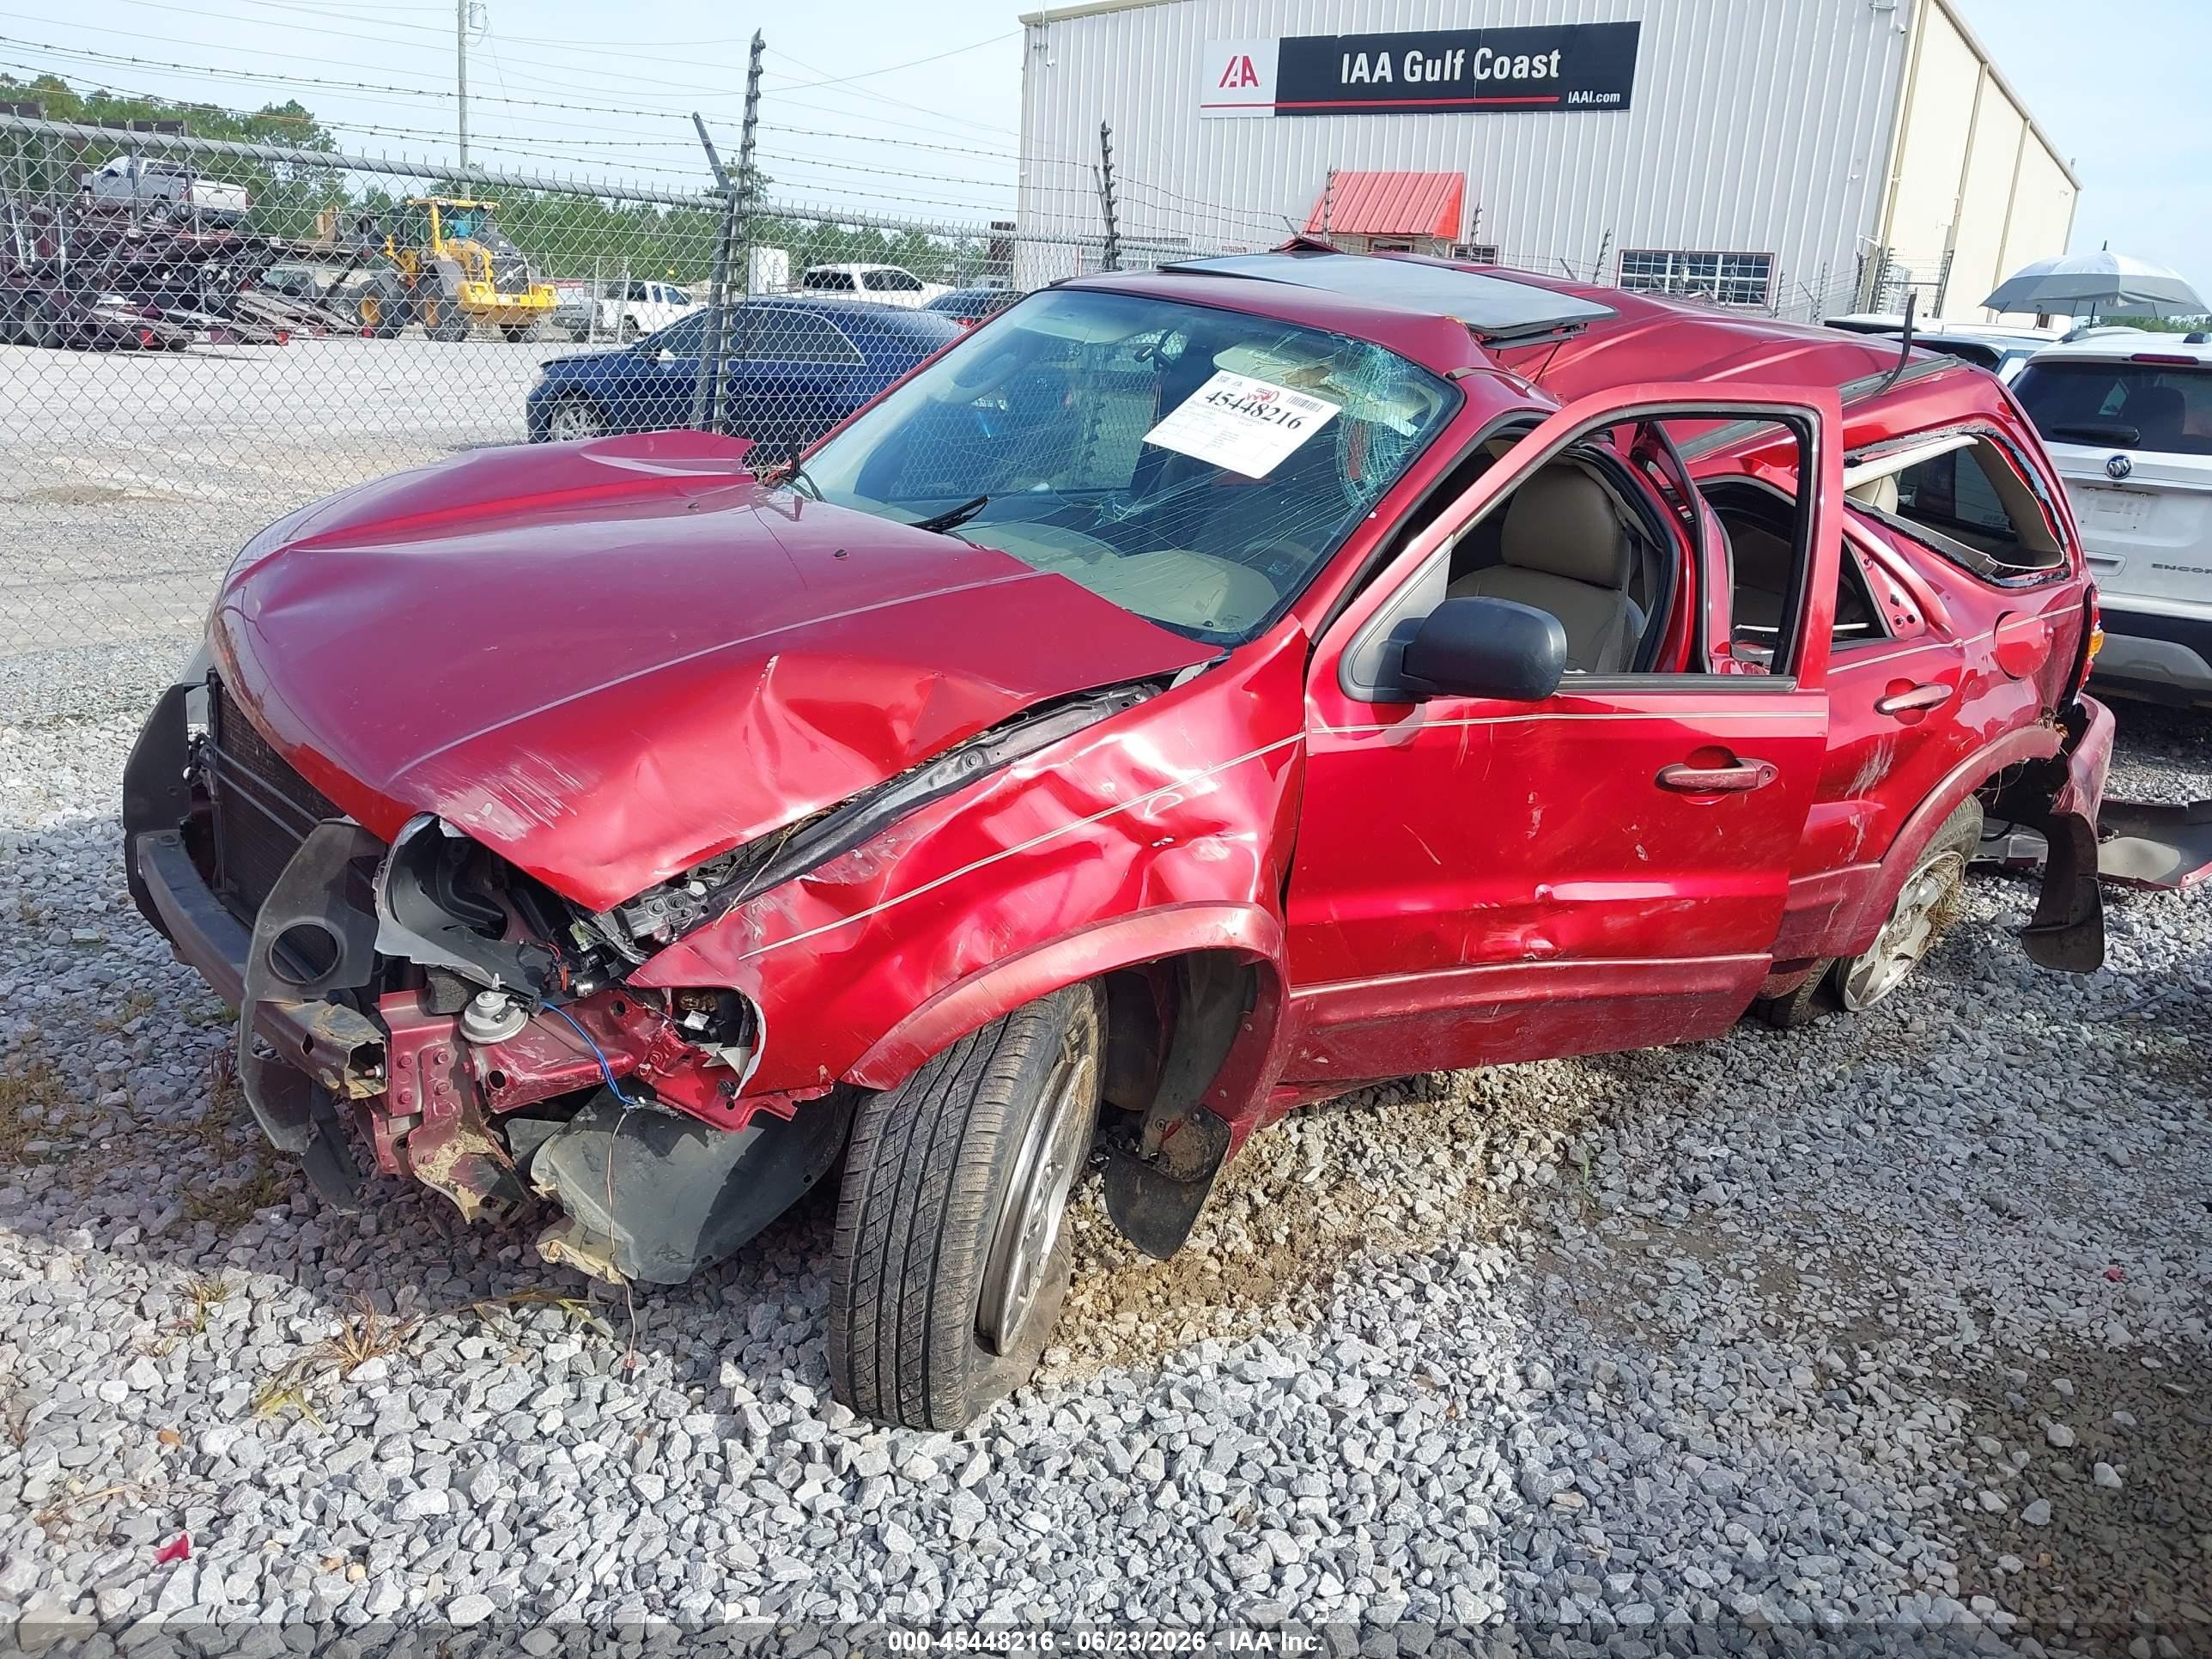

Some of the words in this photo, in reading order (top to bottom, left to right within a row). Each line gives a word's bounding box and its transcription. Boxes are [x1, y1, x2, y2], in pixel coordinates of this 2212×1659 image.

[1341, 52, 1393, 84] IAA
[1403, 49, 1465, 82] Gulf
[1474, 47, 1561, 81] Coast
[1567, 90, 1621, 105] IAAI.com
[1205, 390, 1312, 430] 45448216
